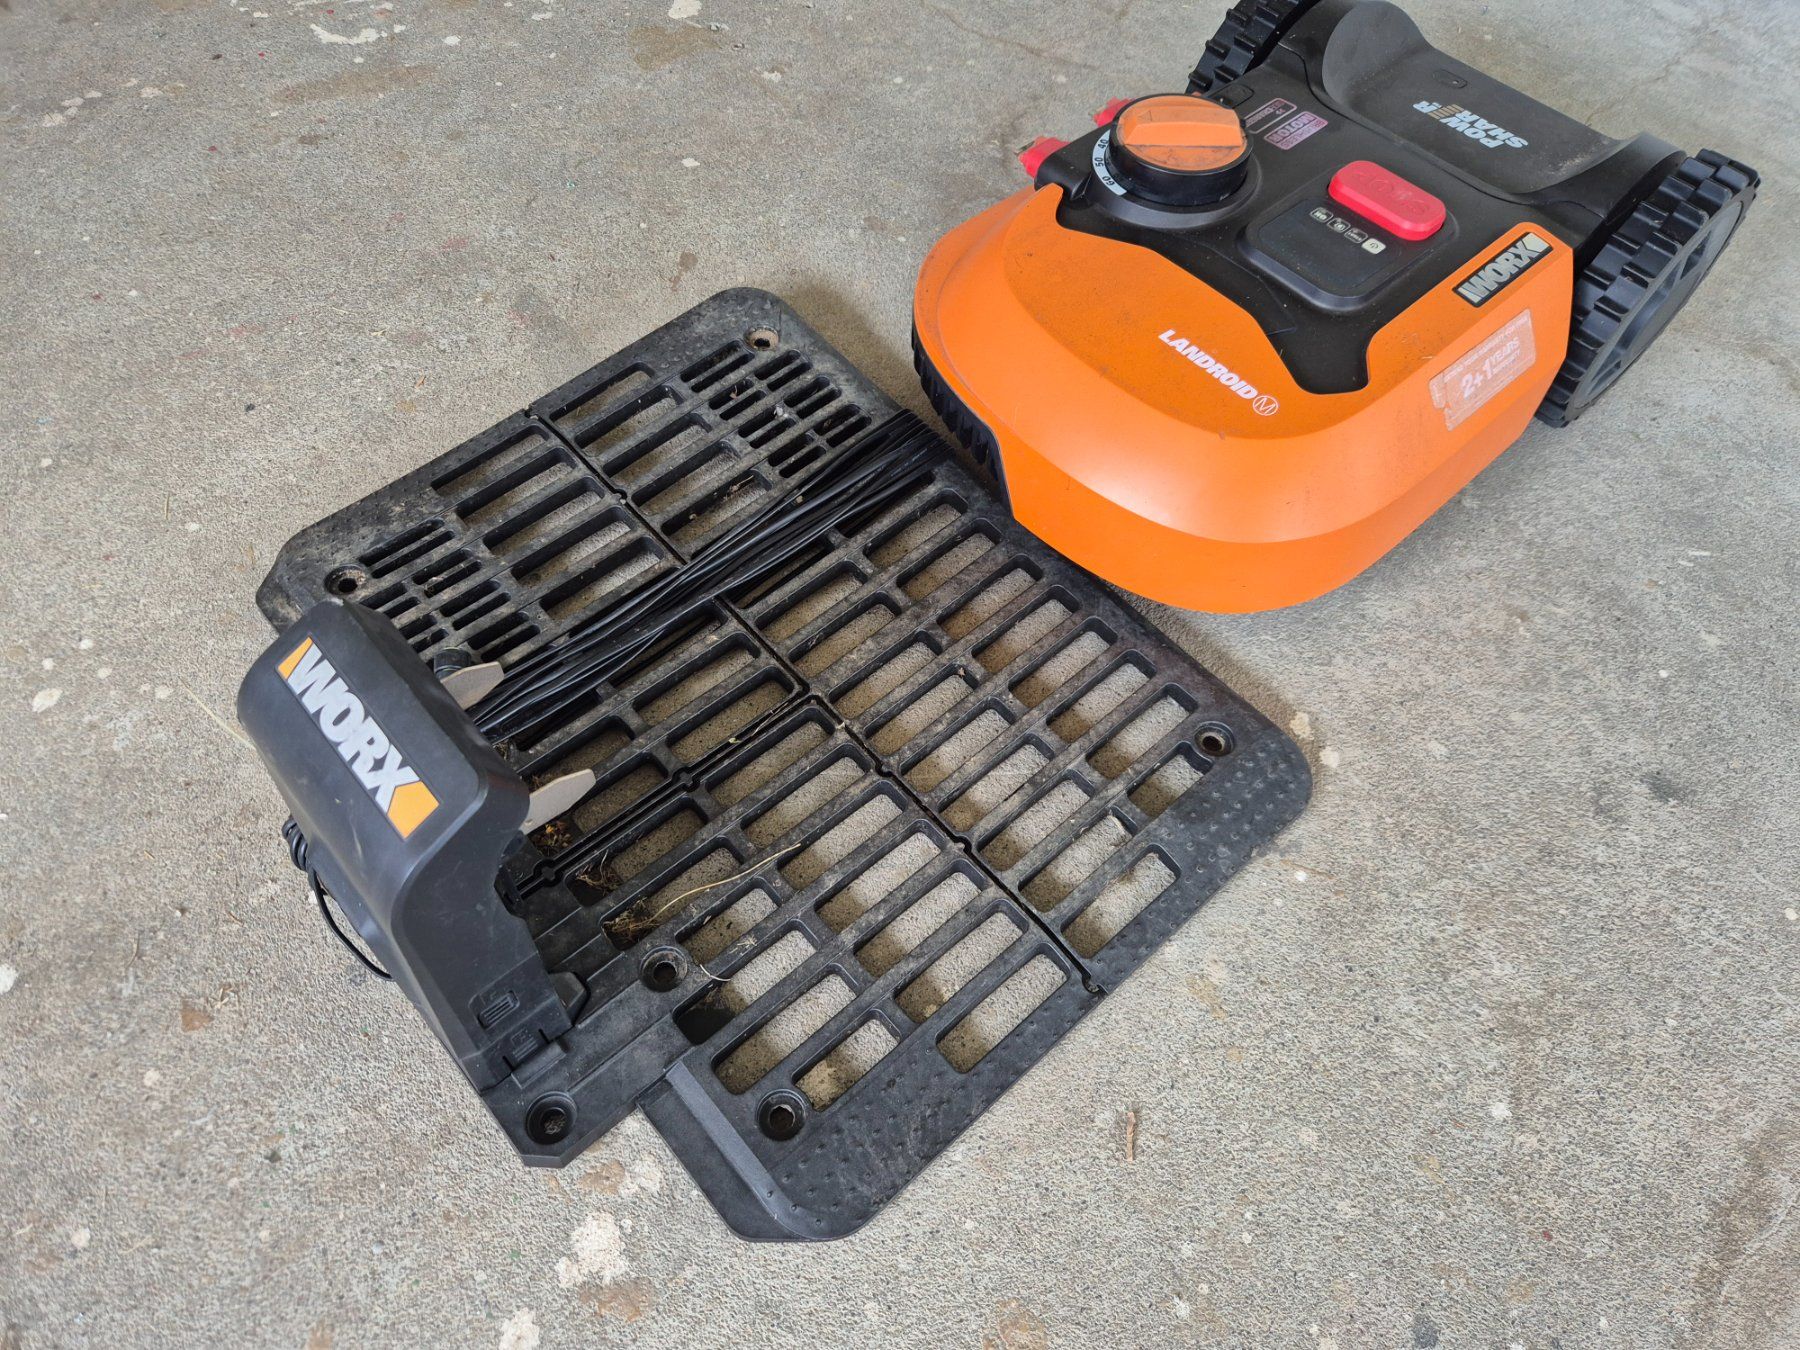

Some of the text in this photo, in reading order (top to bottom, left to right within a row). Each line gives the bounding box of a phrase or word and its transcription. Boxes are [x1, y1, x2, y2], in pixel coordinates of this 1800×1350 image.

[1268, 112, 1316, 141] MOTOR
[1098, 139, 1109, 149] 40
[1094, 157, 1105, 167] 50
[1102, 175, 1115, 186] 60
[1460, 240, 1540, 298] WORX
[1158, 329, 1258, 399] LANDROID
[287, 642, 420, 814] WORX
